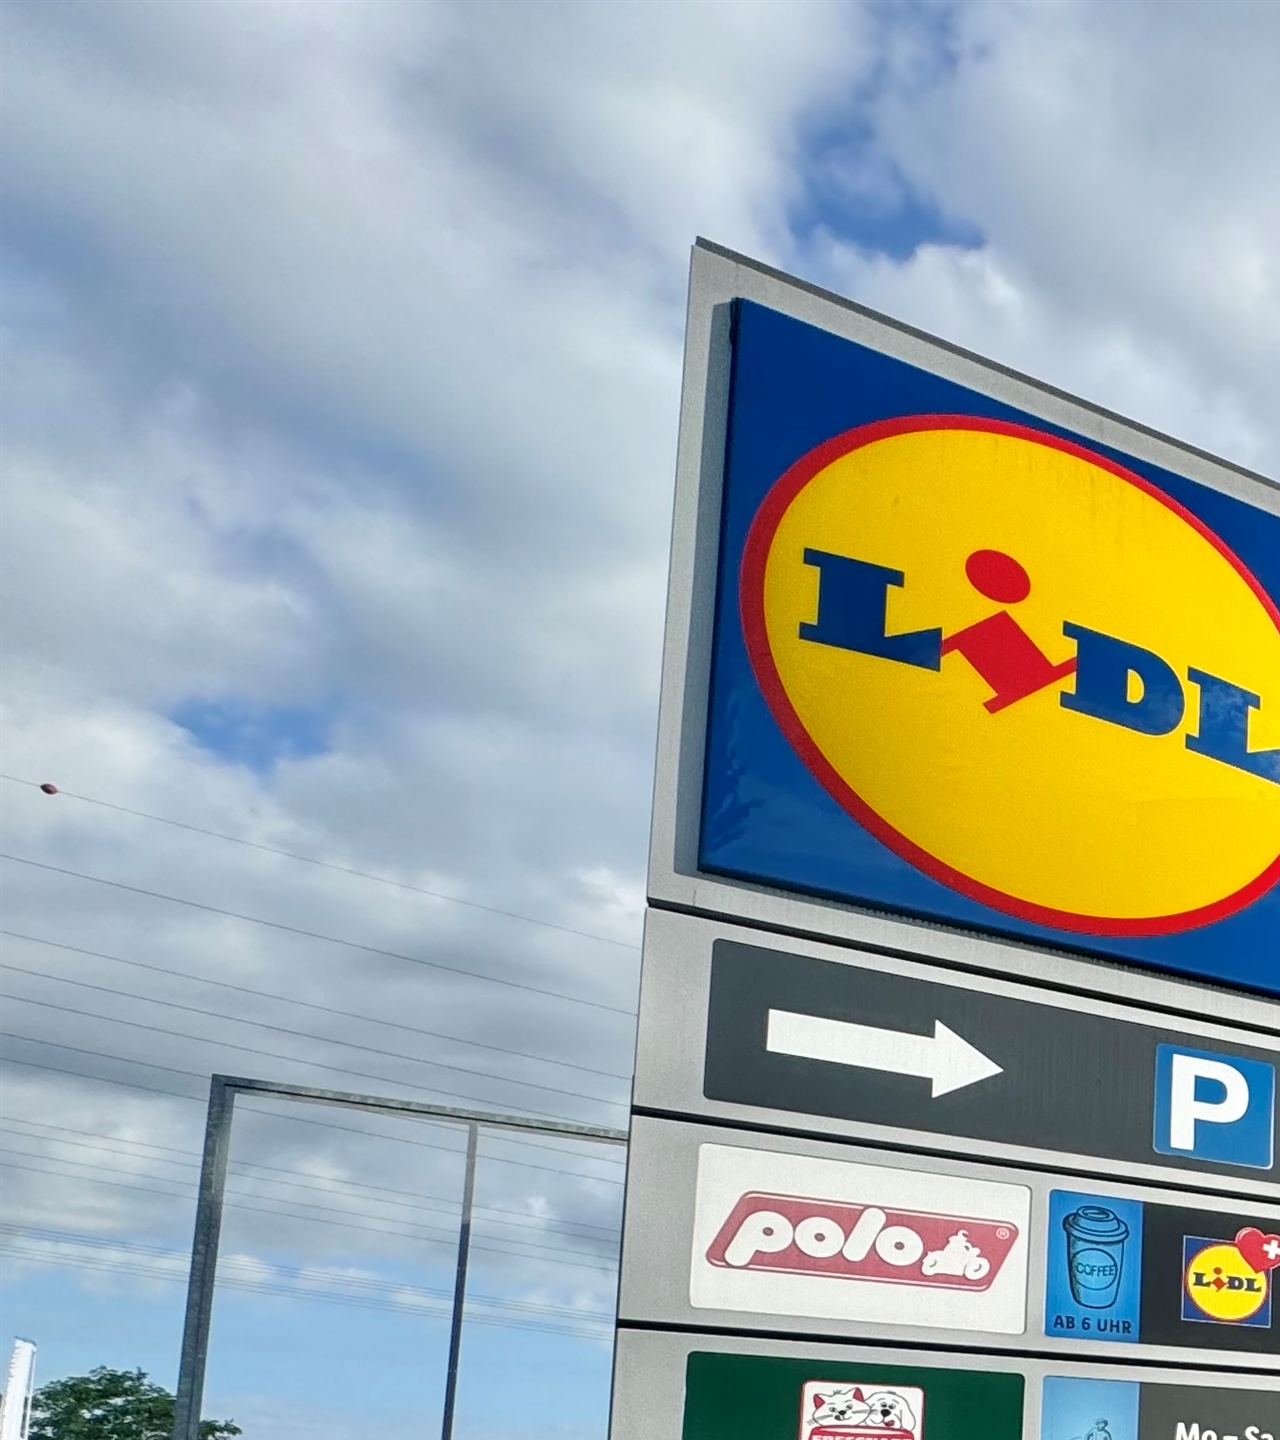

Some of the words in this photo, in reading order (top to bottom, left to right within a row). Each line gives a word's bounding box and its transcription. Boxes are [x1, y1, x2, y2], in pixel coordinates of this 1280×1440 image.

[1170, 1053, 1249, 1151] P
[724, 1207, 924, 1267] polo
[1076, 1262, 1116, 1277] COFFEE
[1053, 1314, 1075, 1330] AB
[1081, 1316, 1091, 1331] 6
[1097, 1318, 1132, 1334] UHR
